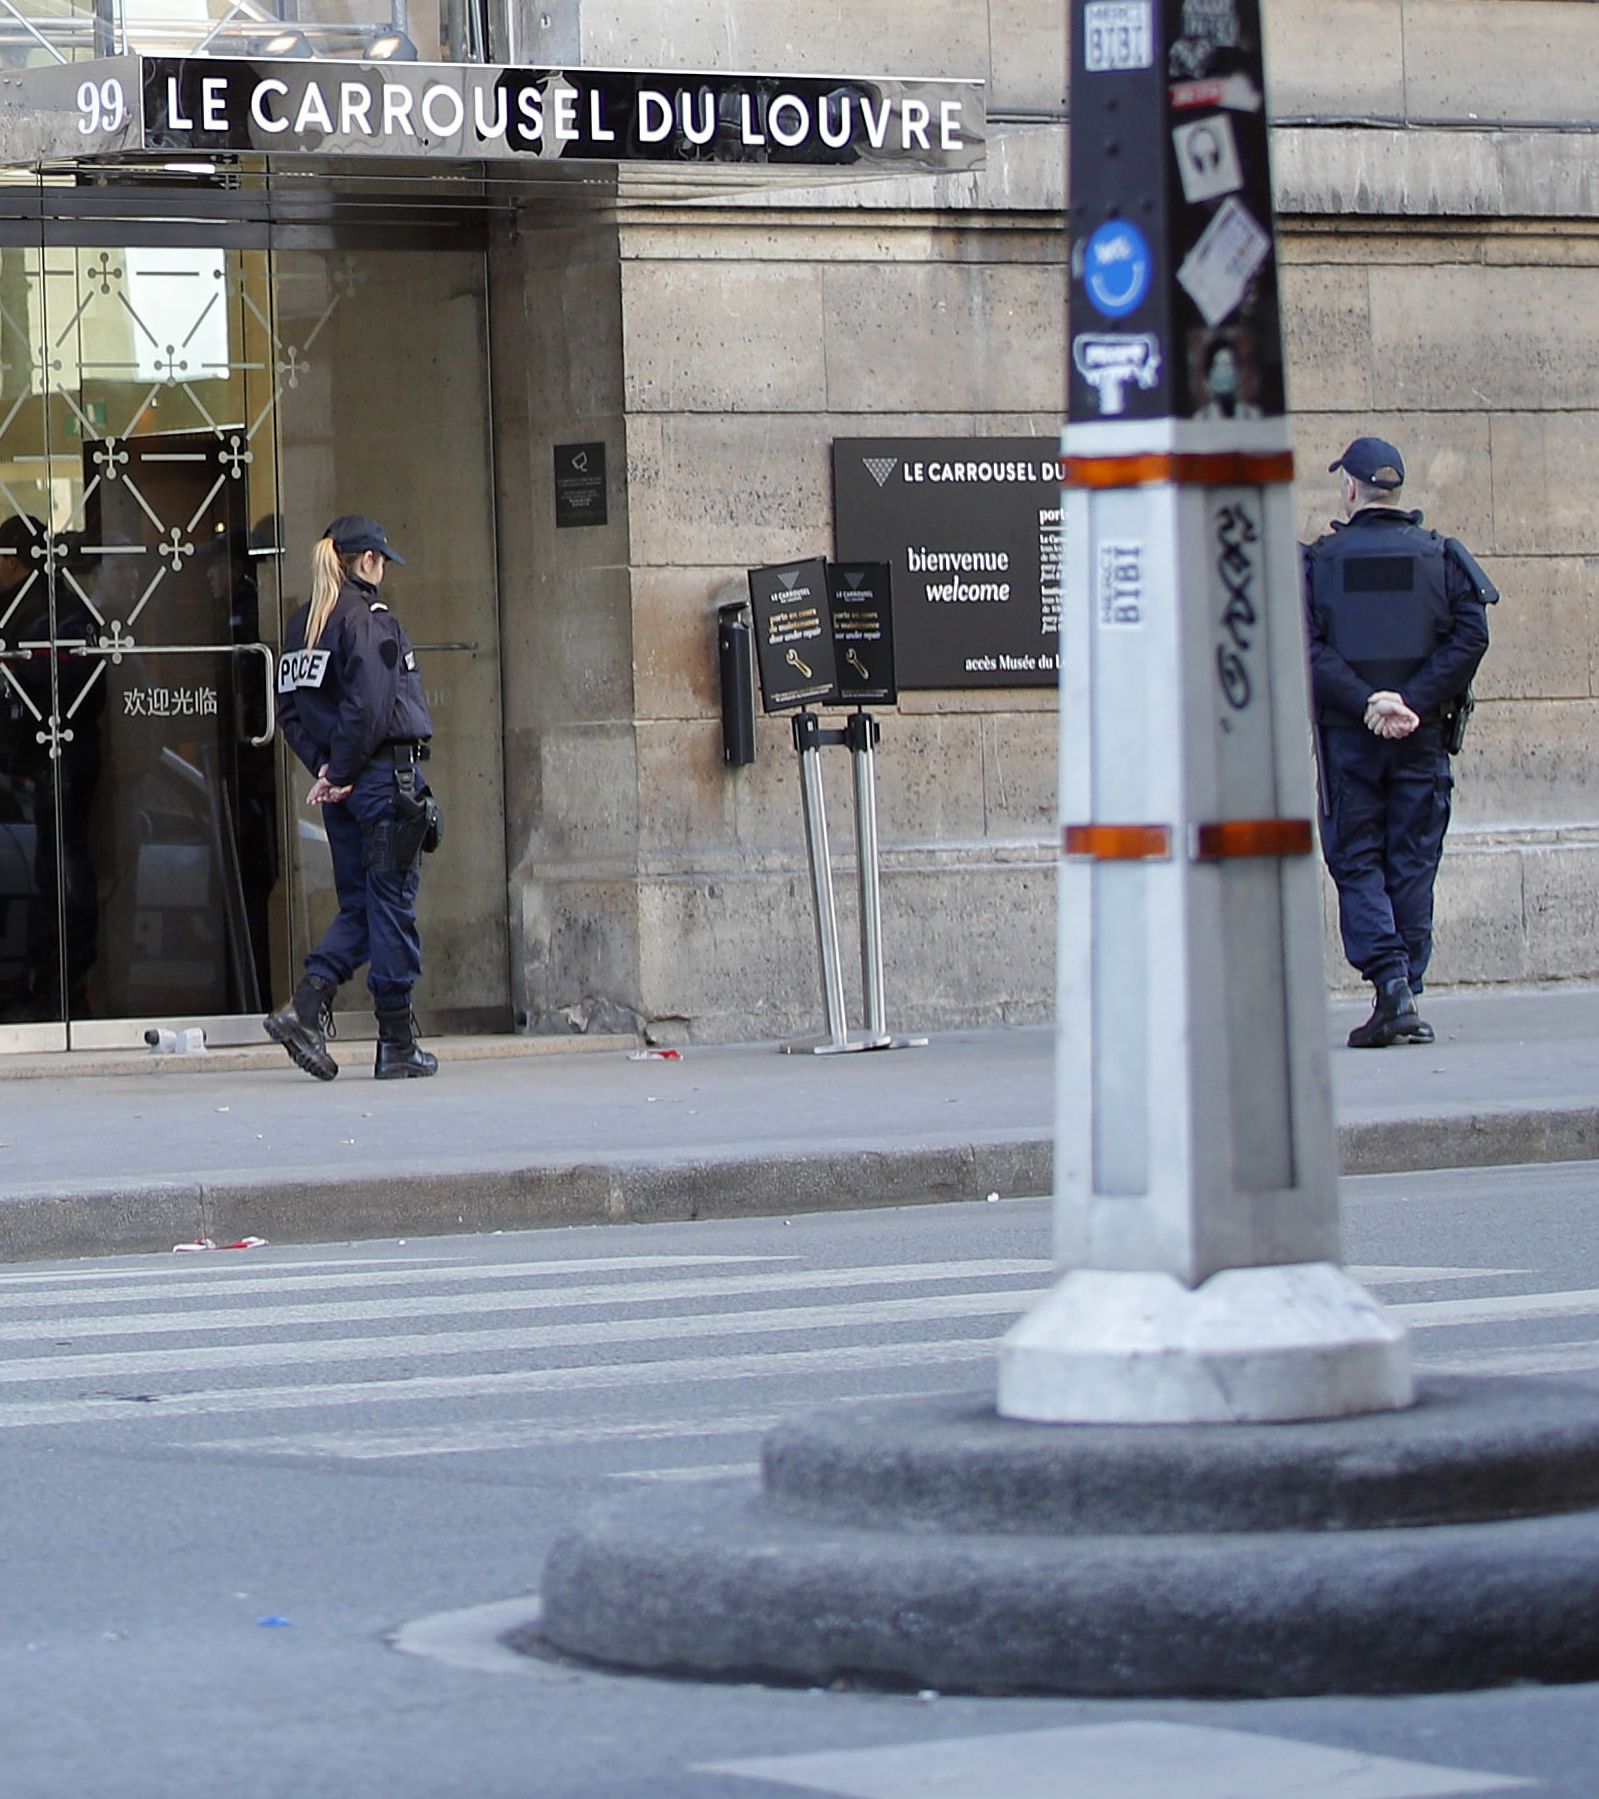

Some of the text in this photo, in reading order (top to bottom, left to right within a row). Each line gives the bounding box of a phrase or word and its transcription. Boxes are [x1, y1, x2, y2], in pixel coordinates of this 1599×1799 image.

[77, 78, 124, 134] 99
[167, 76, 964, 150] LE CARROUSEL DU LOUVRE
[904, 462, 1066, 482] LE CARROUSEL DU
[1039, 508, 1066, 525] port
[908, 546, 1009, 571] bienvenue
[926, 575, 1010, 601] welcome
[965, 654, 997, 670] accès
[999, 653, 1035, 670] Musée
[1038, 653, 1053, 669] du
[123, 686, 218, 717] 欢迎光临
